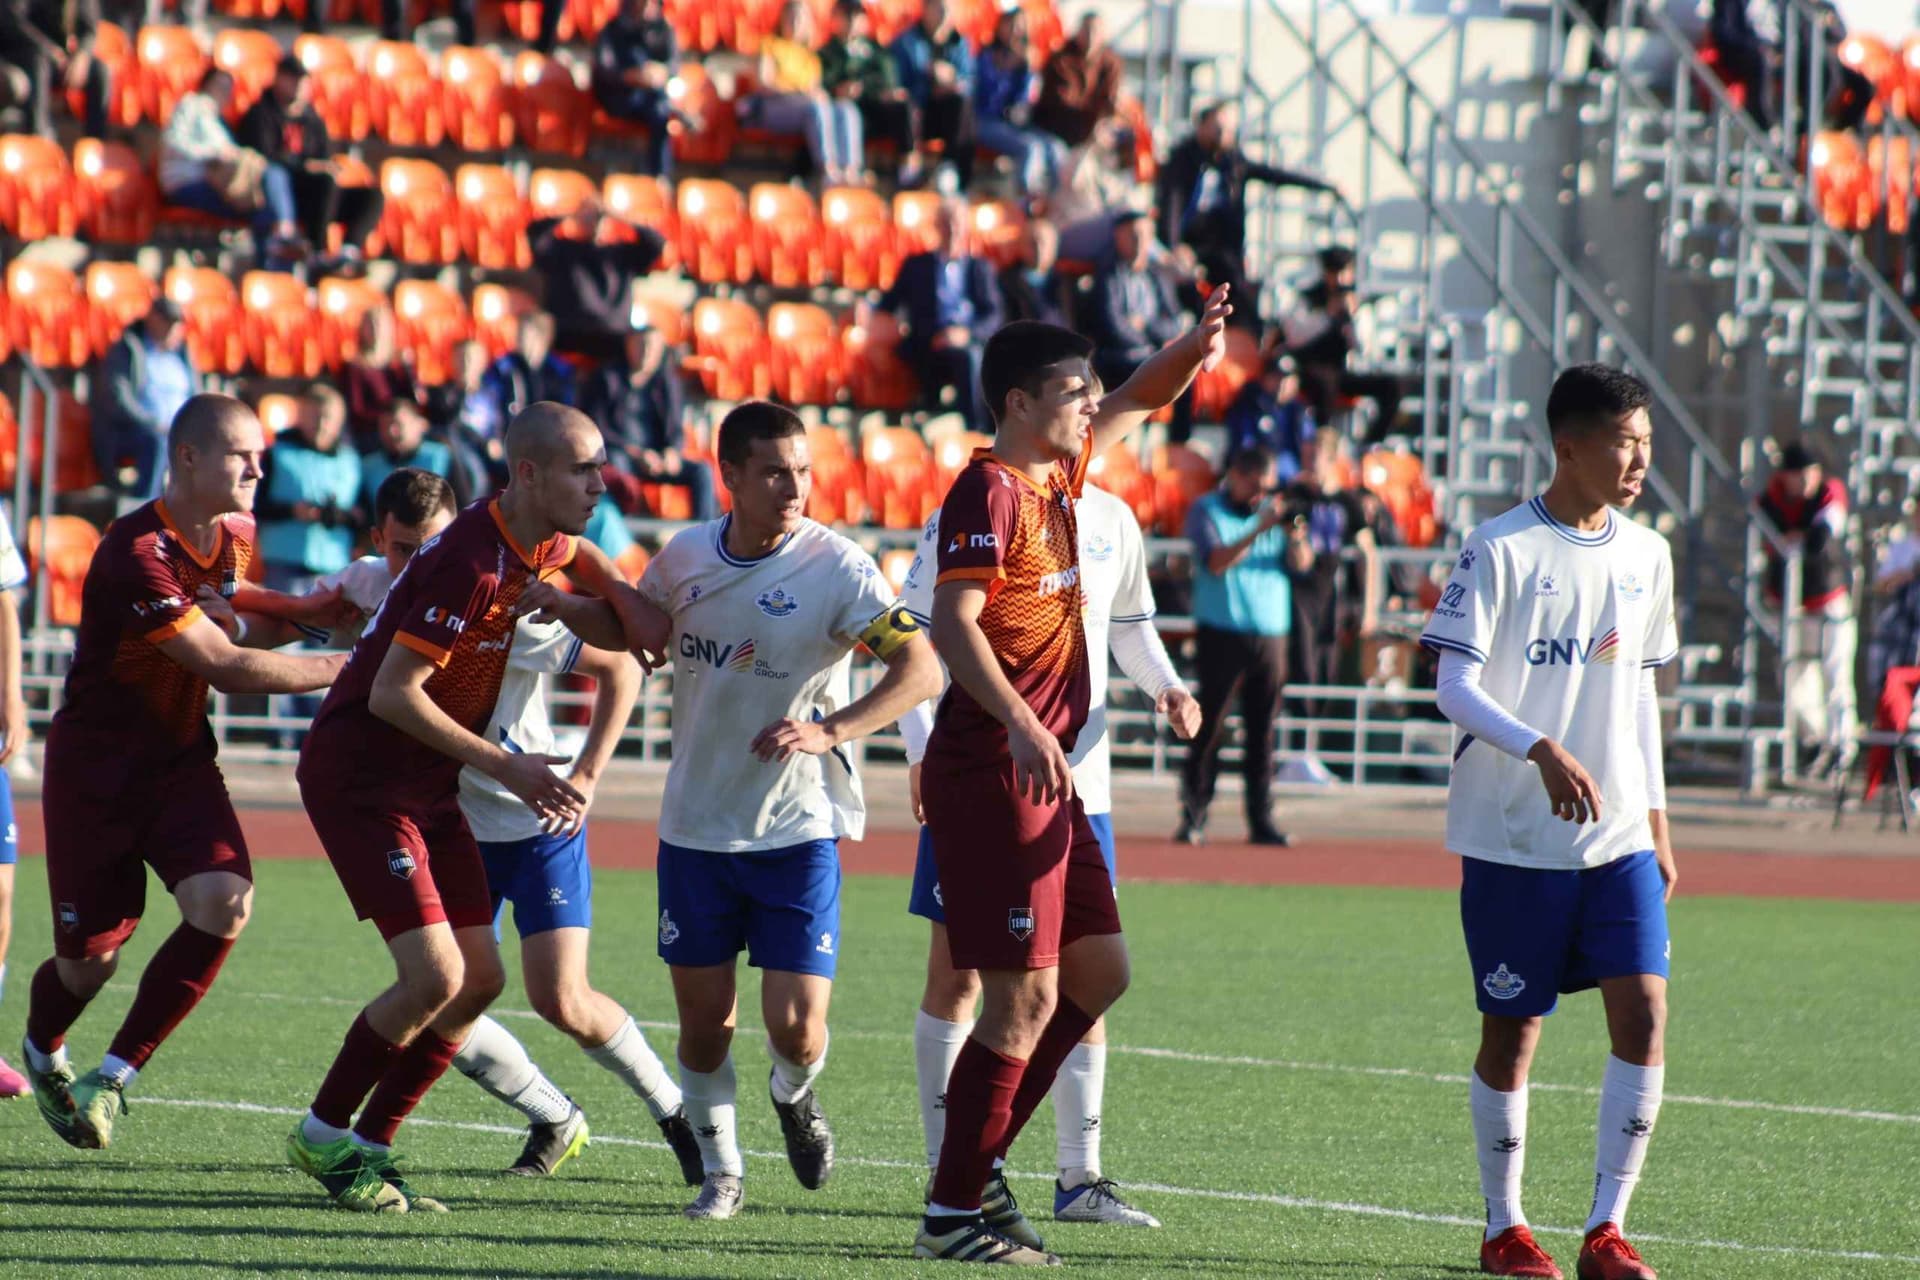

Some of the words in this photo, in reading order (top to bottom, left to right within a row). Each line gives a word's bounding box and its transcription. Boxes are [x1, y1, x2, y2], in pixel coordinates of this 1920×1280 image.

[1434, 607, 1466, 618] ОСТЕР
[680, 632, 732, 668] GNV
[1525, 637, 1595, 665] GNV
[755, 659, 771, 669] OIL
[754, 667, 789, 679] GROUP
